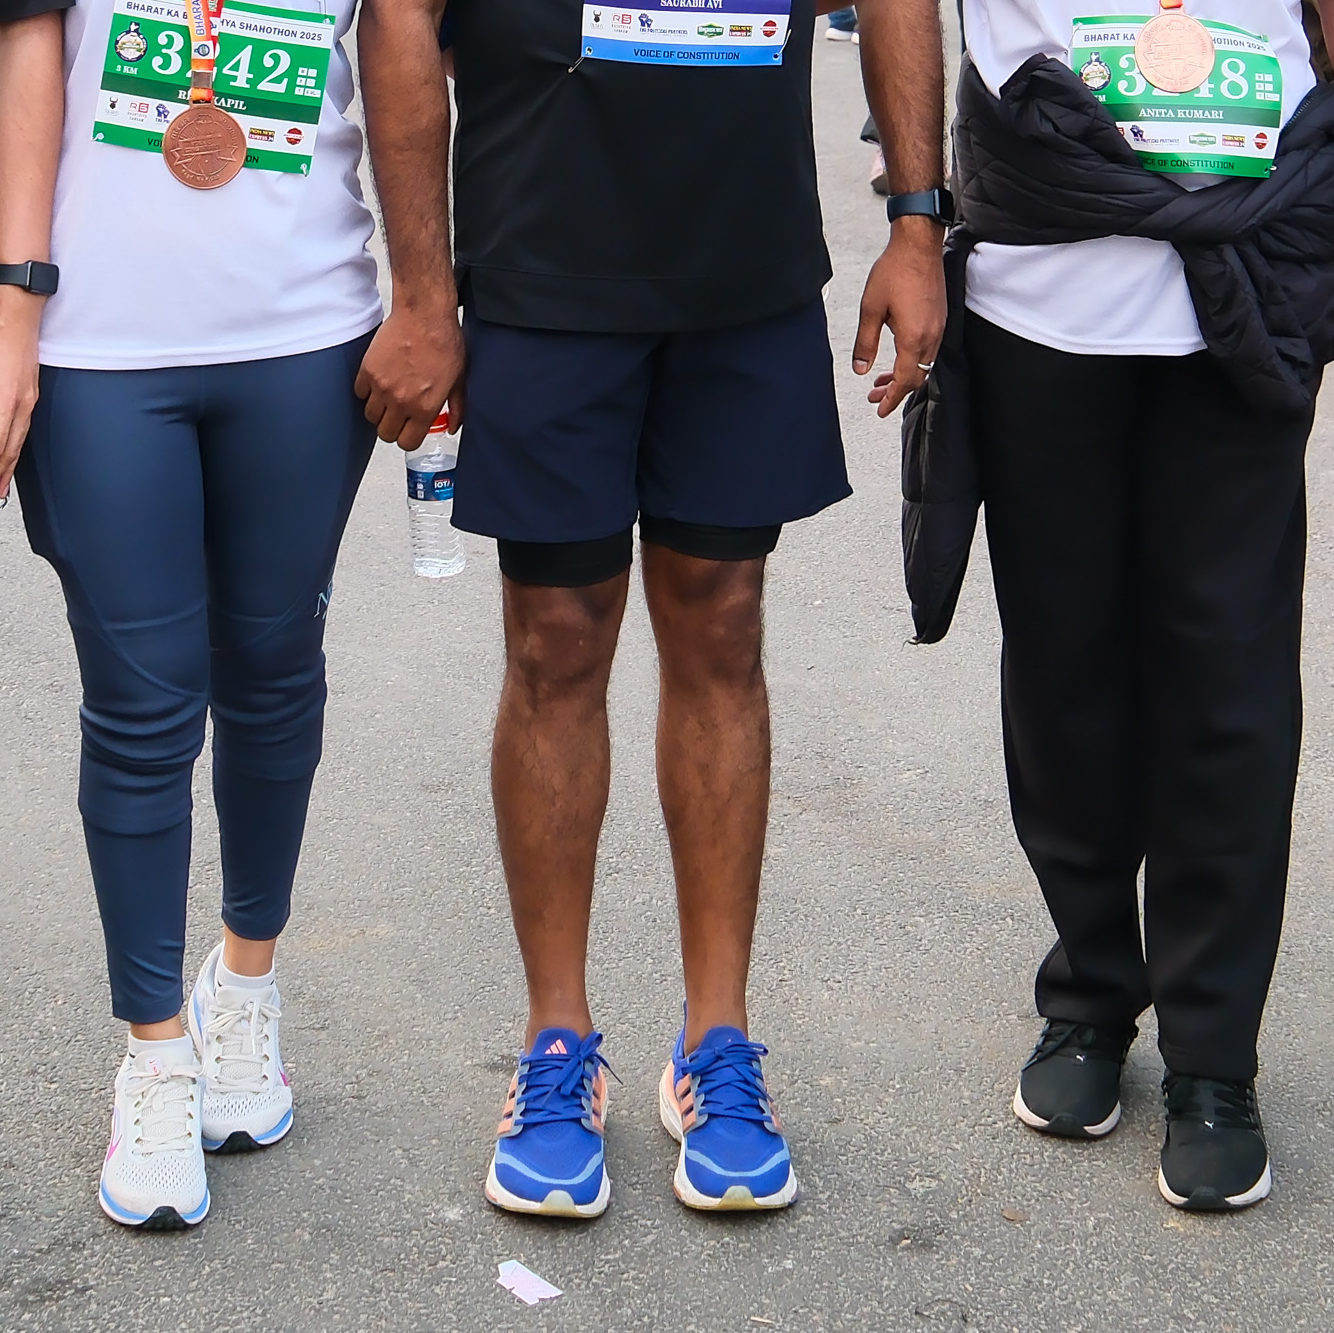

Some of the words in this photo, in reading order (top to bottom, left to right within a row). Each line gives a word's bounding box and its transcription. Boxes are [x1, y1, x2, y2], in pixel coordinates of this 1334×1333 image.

[126, 1, 165, 15] BHARAT
[166, 8, 180, 18] KA
[238, 21, 298, 38] SHAHOTHON
[299, 31, 323, 42] 2025
[1083, 33, 1121, 42] BHARAT
[1122, 33, 1136, 41] KA
[1246, 42, 1267, 52] 2025
[633, 48, 662, 58] VOICE
[663, 50, 675, 58] OF
[677, 51, 740, 60] CONSTITUTION
[123, 66, 139, 75] KM
[1138, 108, 1175, 119] ANITA
[1177, 109, 1224, 120] KUMARI
[1157, 159, 1169, 167] OF
[1170, 159, 1235, 170] CONSTITUTION
